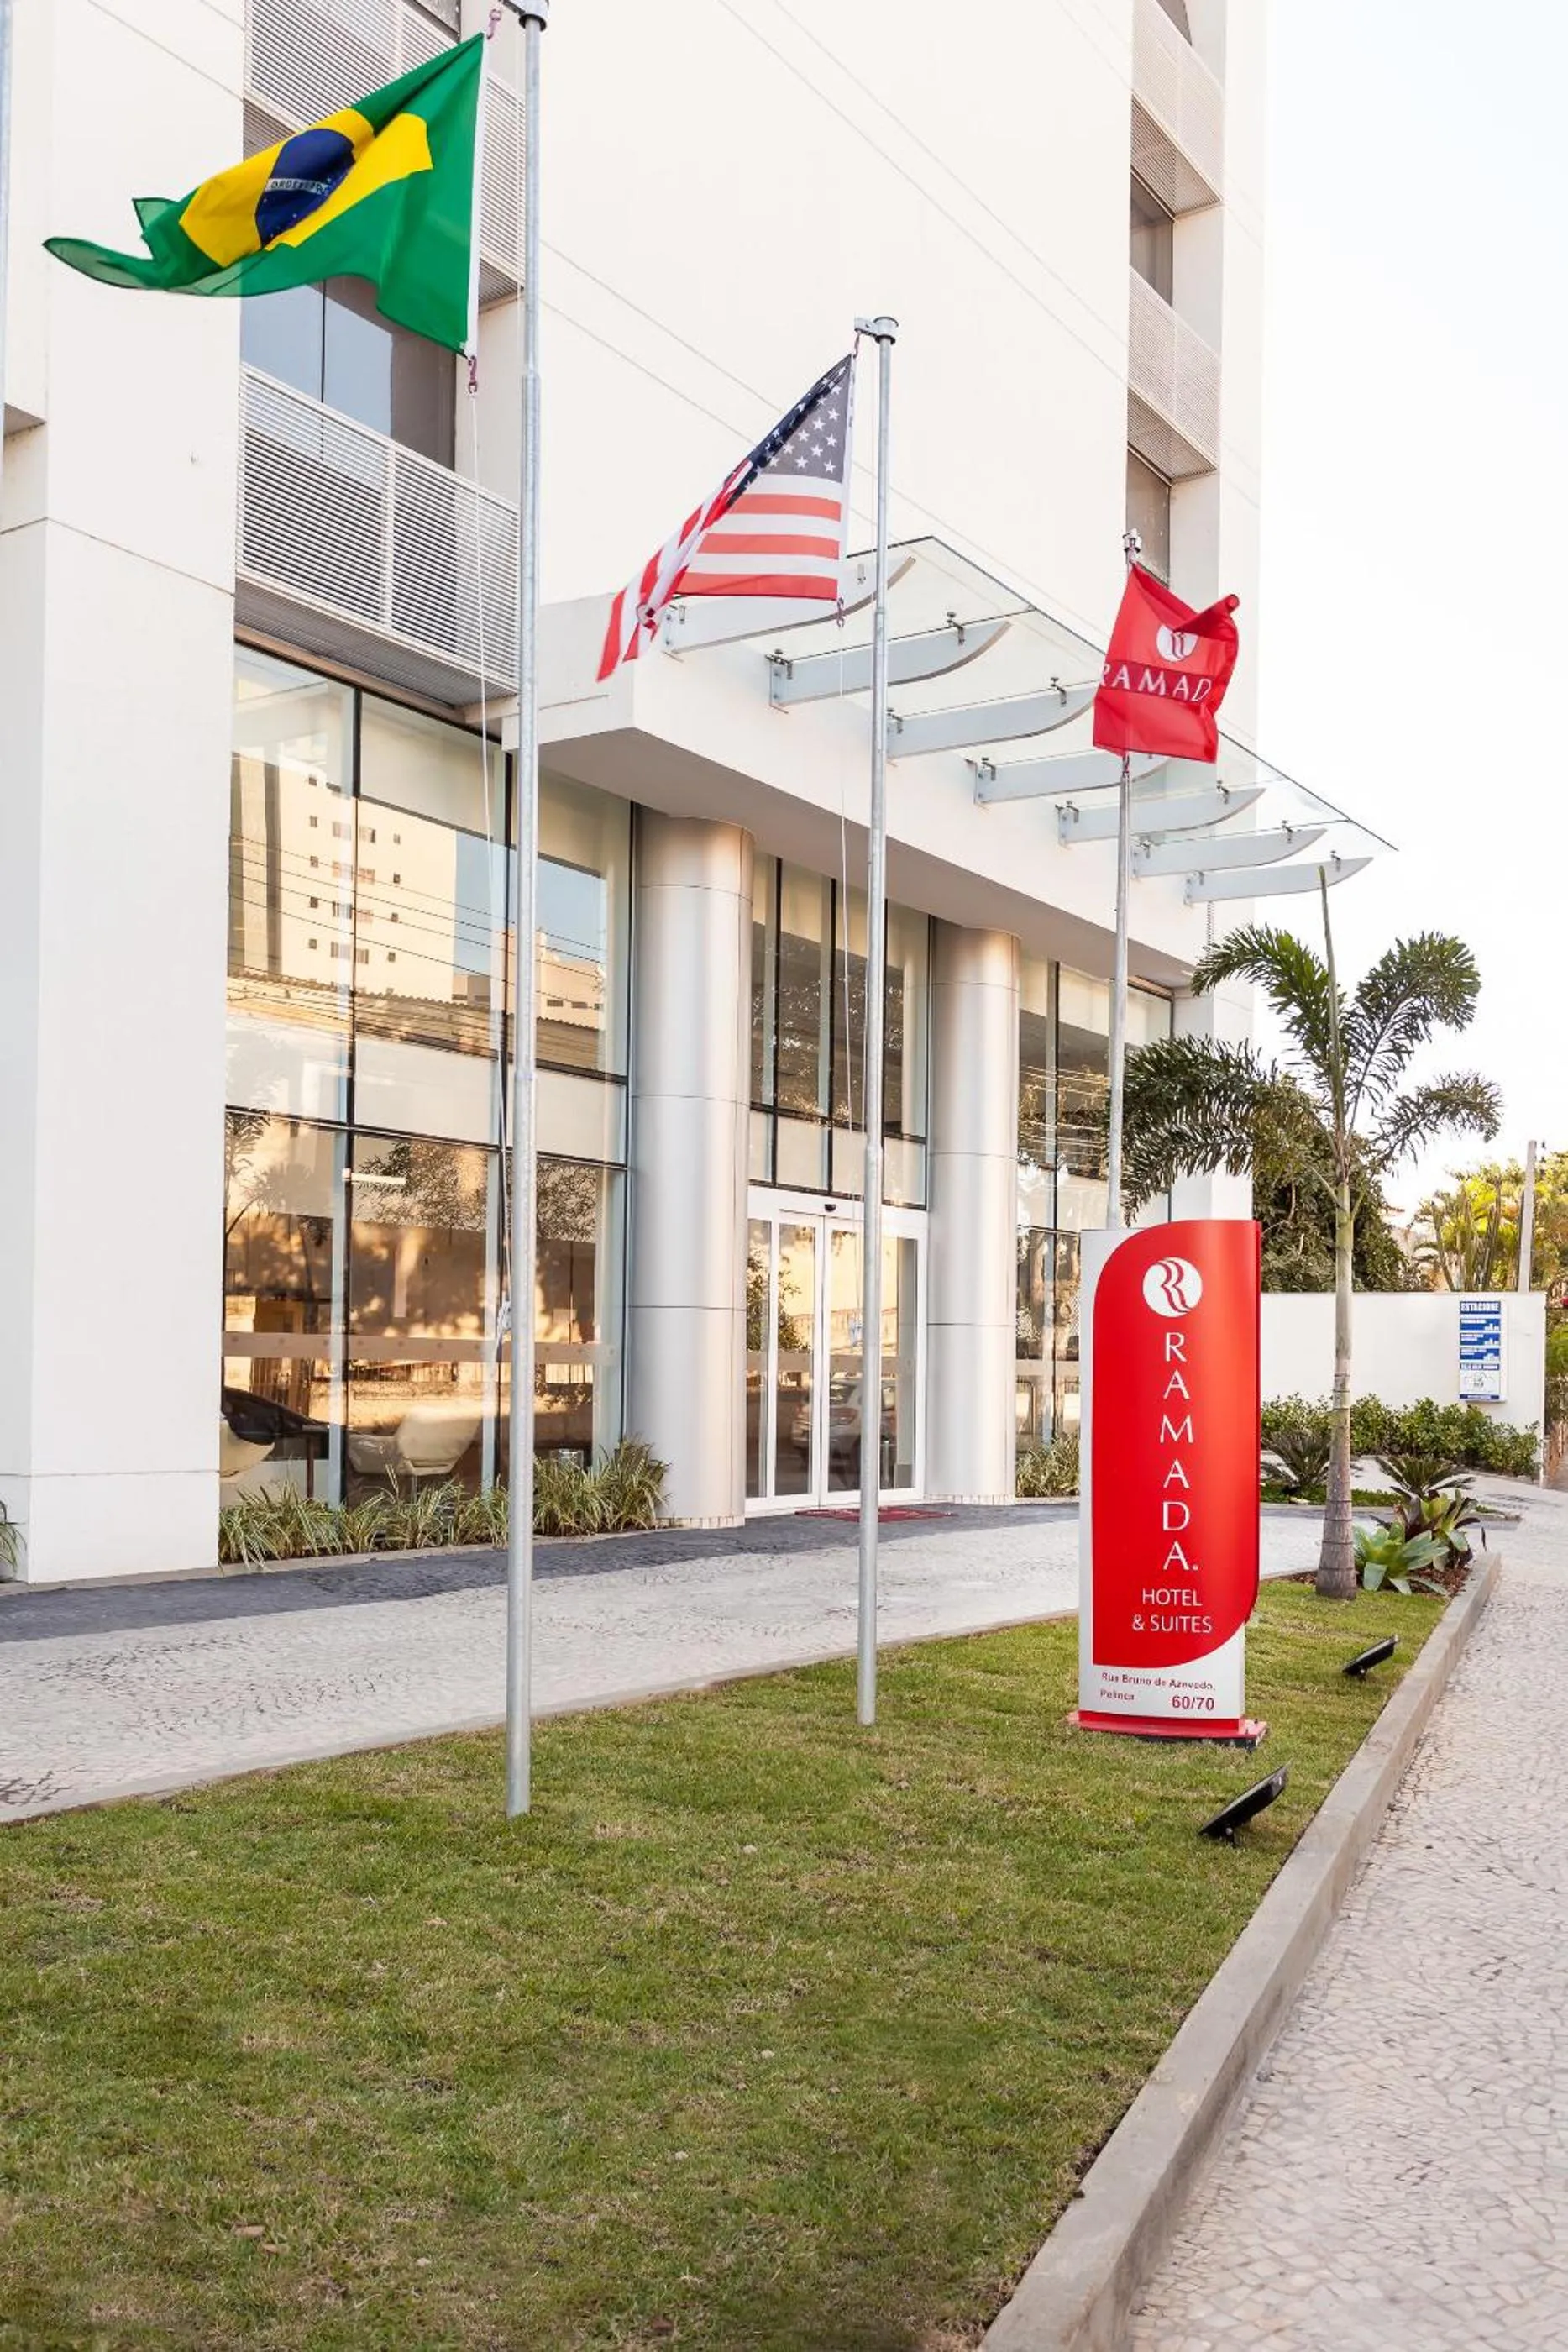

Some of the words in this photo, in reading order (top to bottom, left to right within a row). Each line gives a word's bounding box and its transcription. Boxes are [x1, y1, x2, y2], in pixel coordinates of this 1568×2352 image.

[1100, 664, 1212, 702] RAMAD
[1142, 1588, 1203, 1607] HOTEL
[1132, 1614, 1145, 1631] &
[1150, 1614, 1212, 1634] SUITES
[1101, 1672, 1120, 1683] Rua
[1122, 1674, 1152, 1686] Bruno
[1154, 1677, 1167, 1687] de
[1172, 1695, 1215, 1711] 60/70
